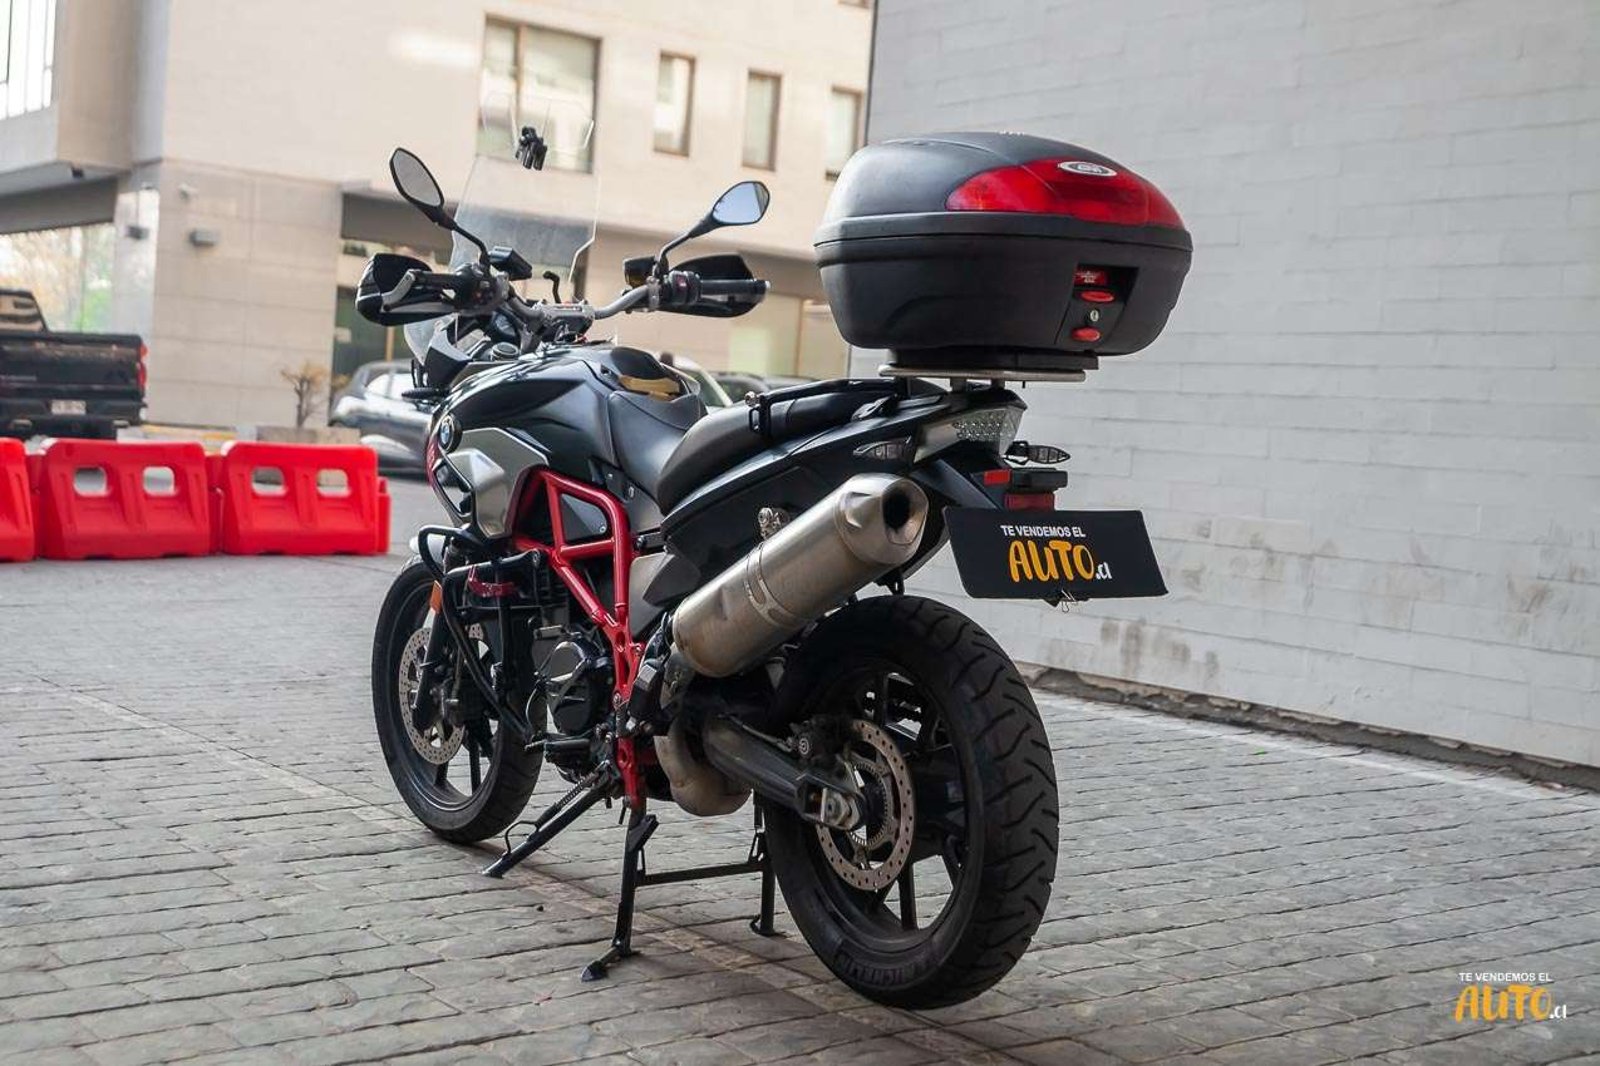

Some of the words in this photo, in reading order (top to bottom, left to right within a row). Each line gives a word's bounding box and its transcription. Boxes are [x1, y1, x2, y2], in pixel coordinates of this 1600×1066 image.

[1001, 525, 1015, 536] TE
[1016, 526, 1071, 537] VENDEMOS
[1072, 527, 1086, 537] EL
